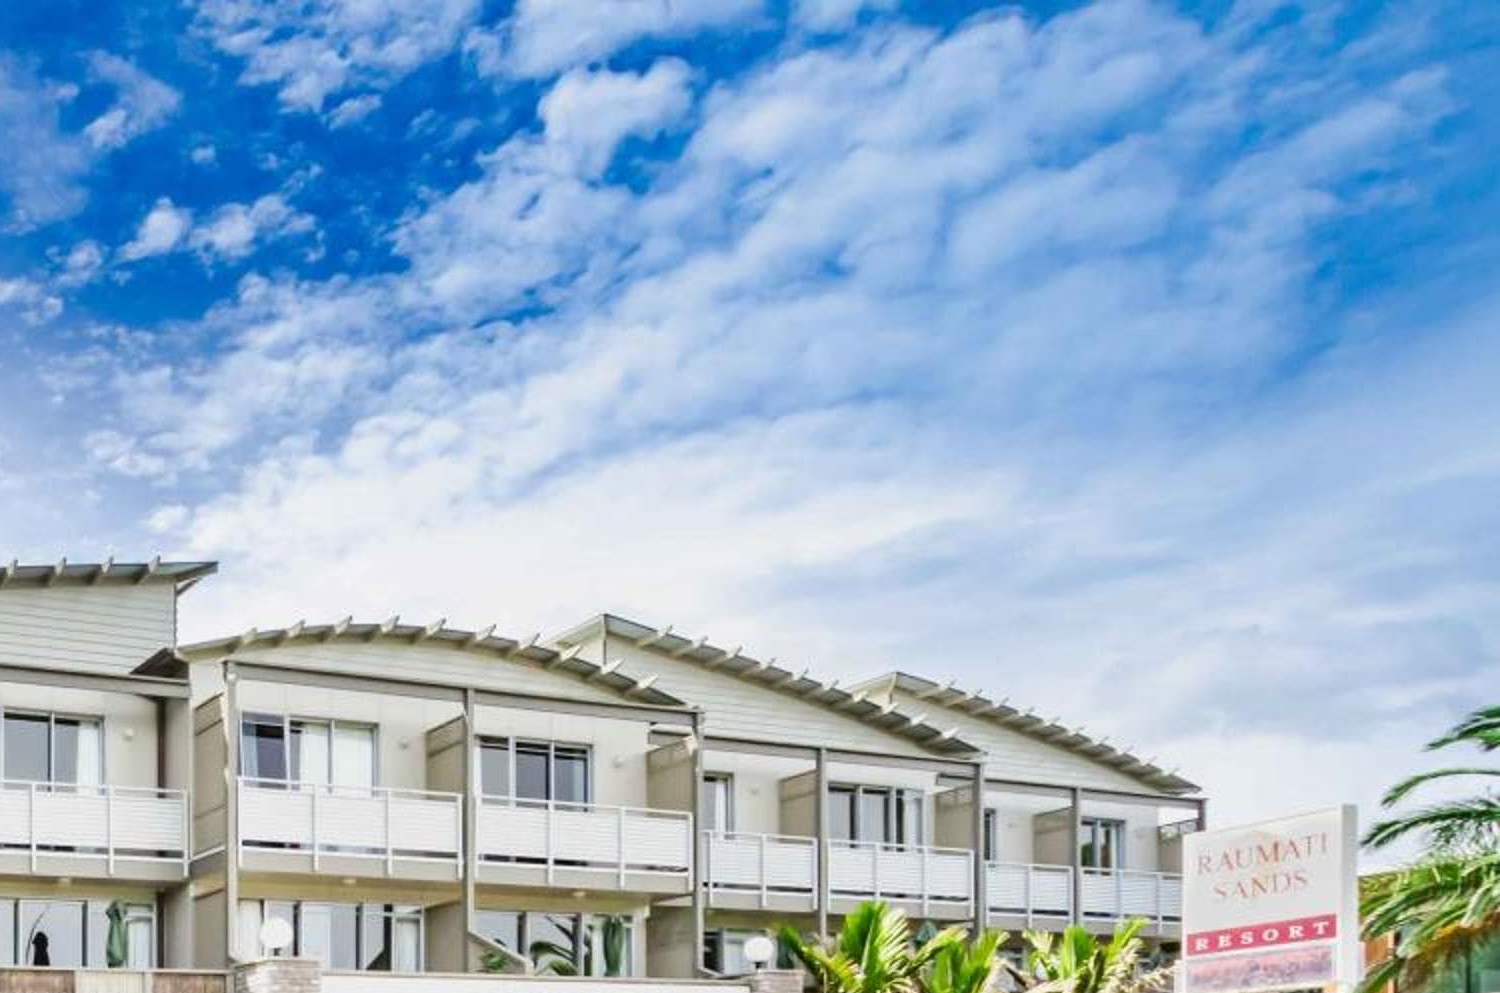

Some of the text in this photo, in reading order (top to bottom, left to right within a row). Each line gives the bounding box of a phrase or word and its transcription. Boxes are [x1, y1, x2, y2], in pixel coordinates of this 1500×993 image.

[1197, 831, 1330, 875] RAUMATI
[1213, 869, 1309, 899] SANDS
[1195, 921, 1330, 951] RESORT
